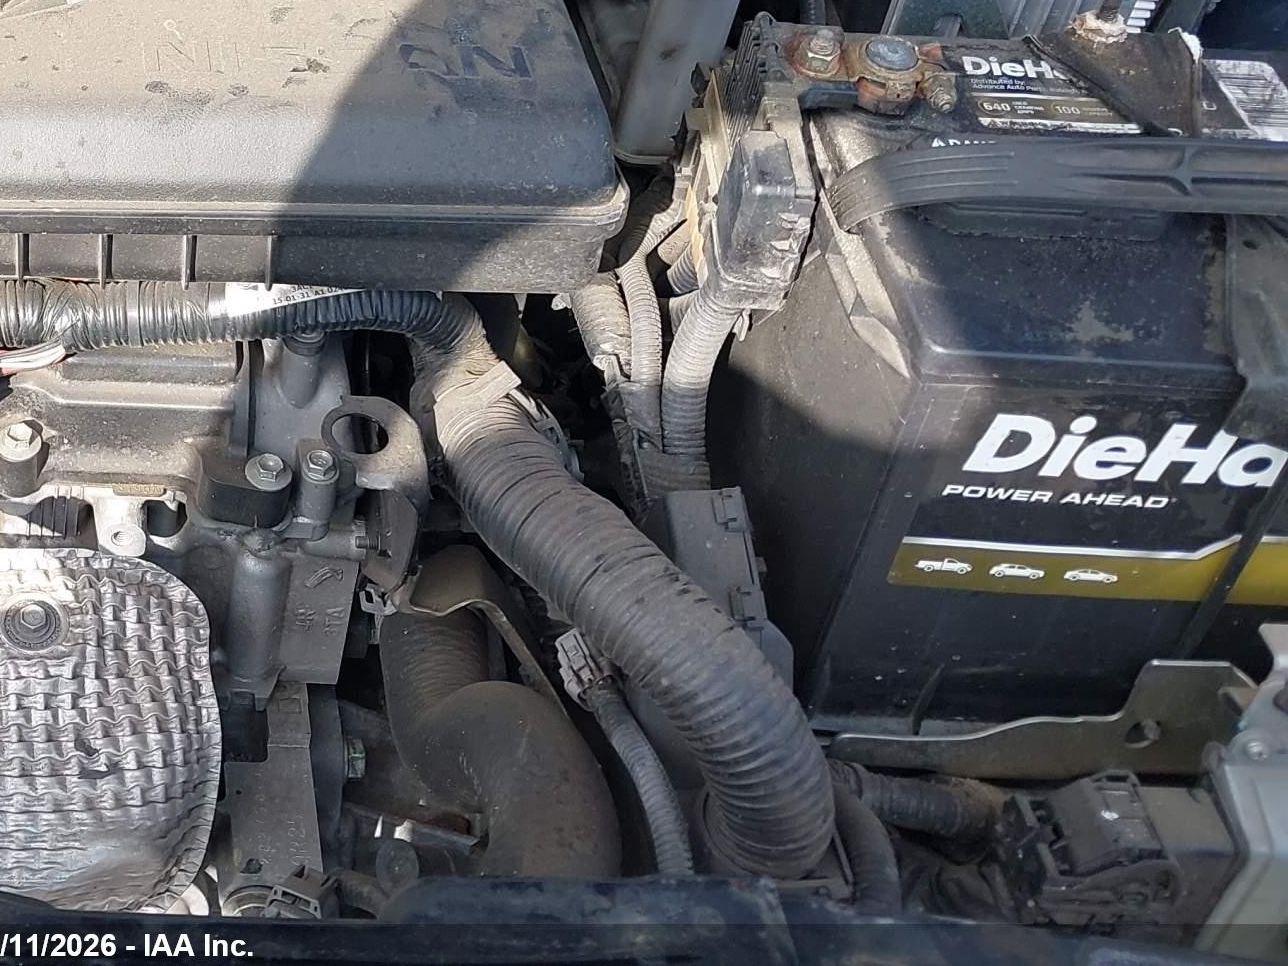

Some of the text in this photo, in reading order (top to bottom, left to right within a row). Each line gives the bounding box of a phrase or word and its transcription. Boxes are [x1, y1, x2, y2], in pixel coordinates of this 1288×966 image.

[982, 101, 1011, 112] 640
[1055, 105, 1081, 115] 100
[942, 484, 1054, 503] POWER
